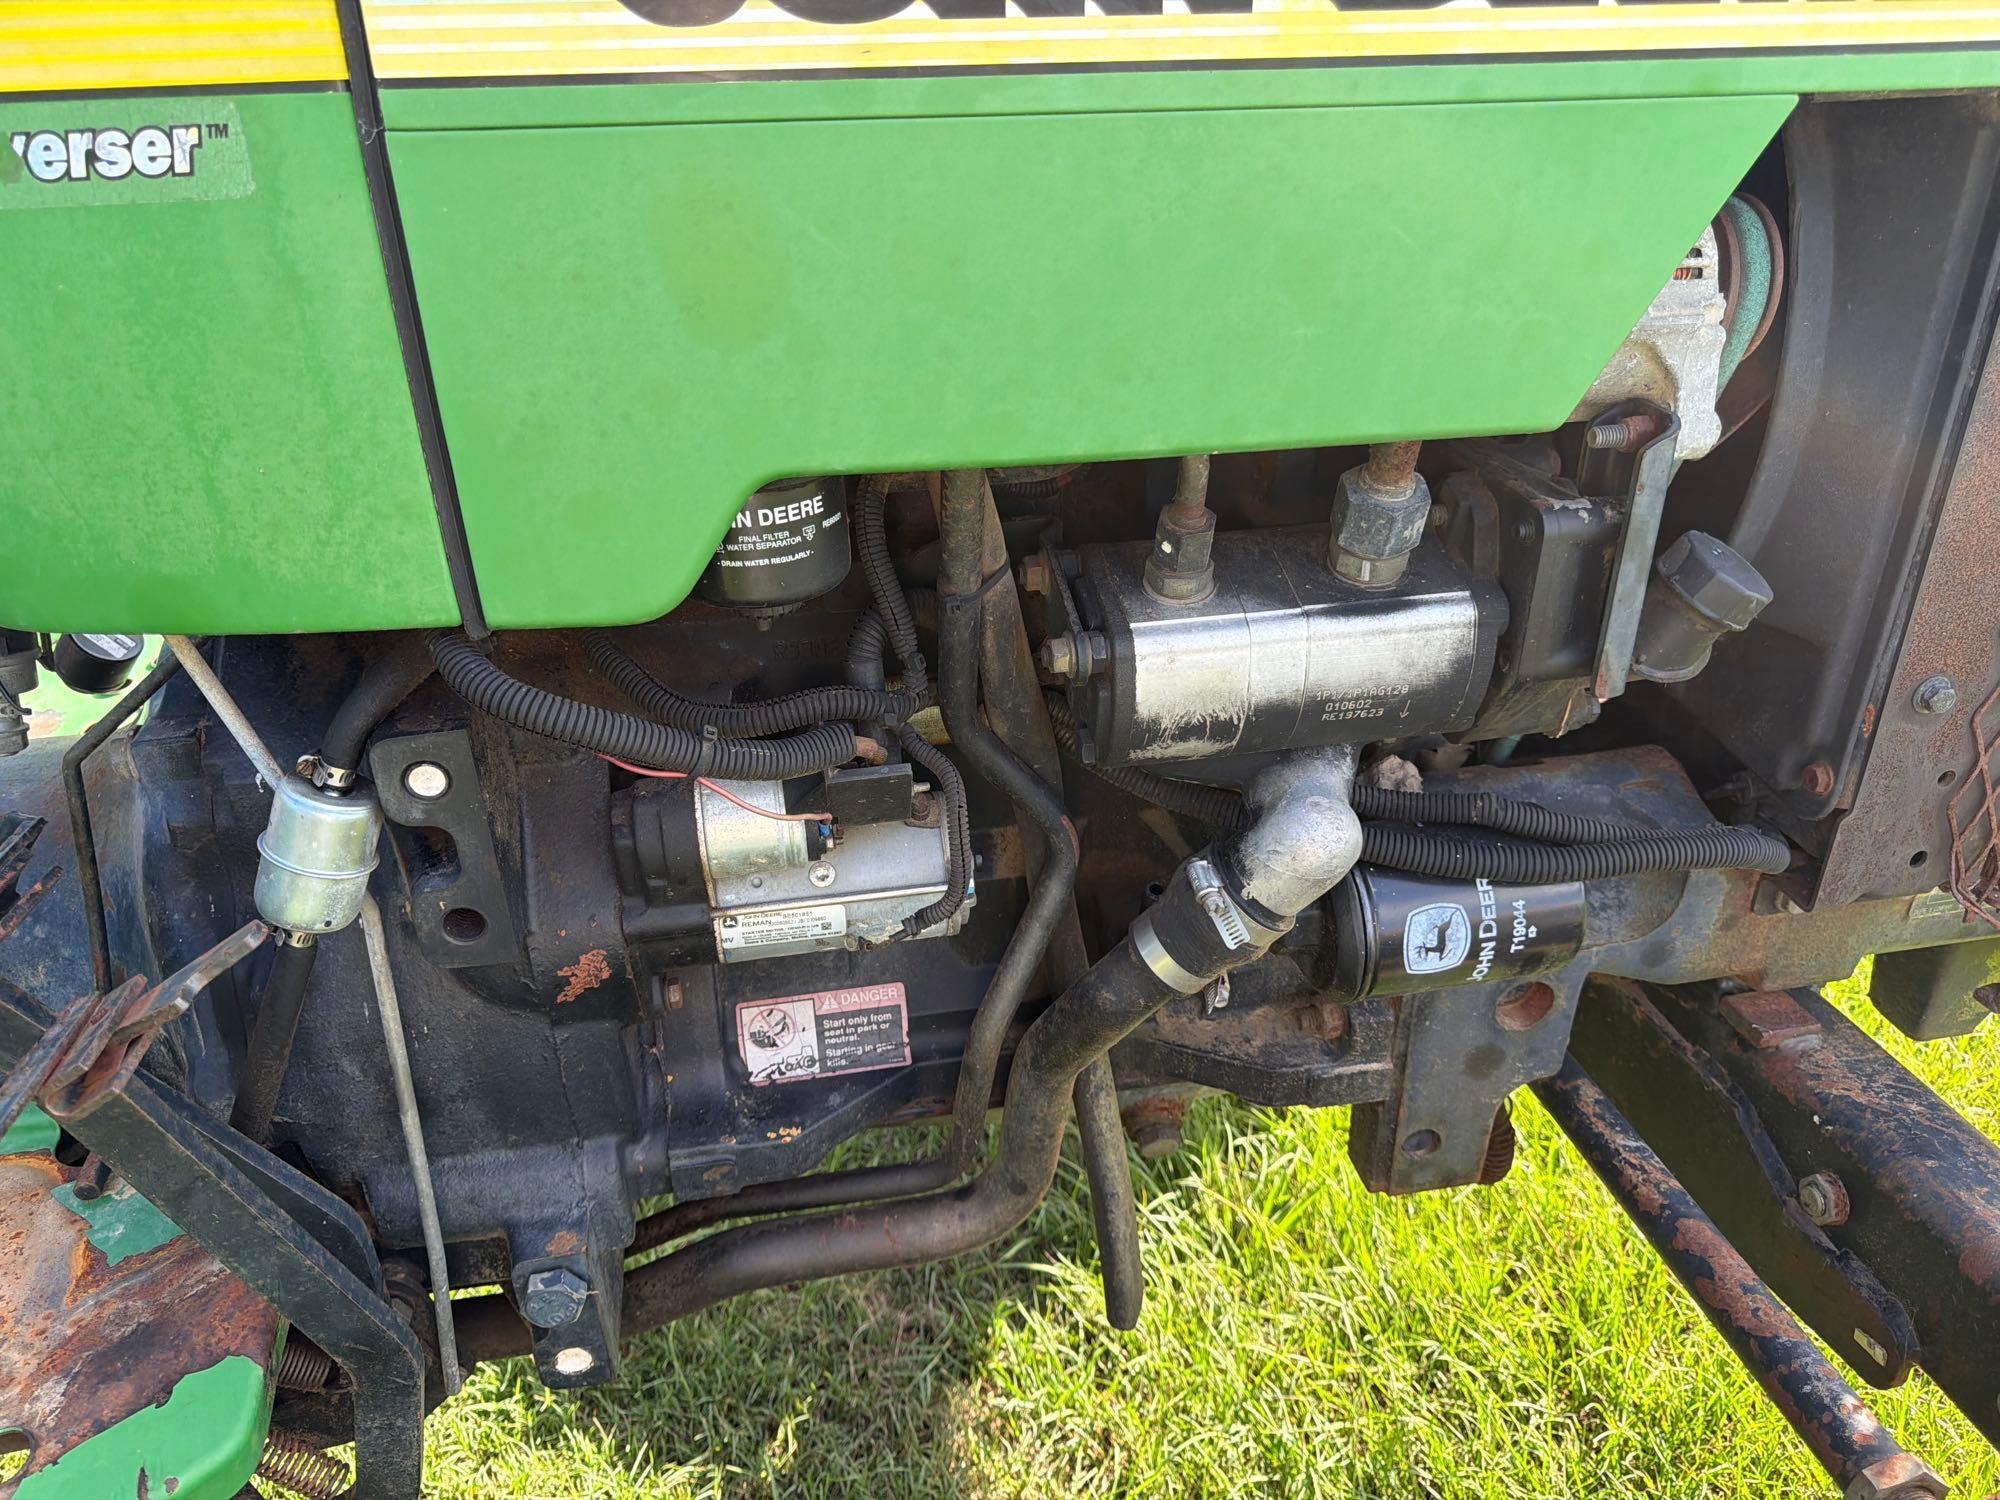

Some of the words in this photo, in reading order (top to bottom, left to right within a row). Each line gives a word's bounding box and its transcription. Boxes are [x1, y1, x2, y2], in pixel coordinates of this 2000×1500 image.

[731, 511, 752, 528] N
[757, 495, 824, 527] DEERE
[726, 543, 755, 551] WATER
[755, 536, 802, 550] SEPARATOR
[738, 535, 761, 543] FINAL
[762, 531, 790, 541] FILTER
[744, 558, 769, 567] WATER
[770, 550, 811, 564] REGULARLY
[1325, 700, 1372, 712] 010602
[1321, 708, 1384, 721] RE197623
[1475, 878, 1498, 938] DEER
[742, 920, 772, 928] REMAN
[1510, 899, 1526, 954] T19044
[1466, 940, 1495, 982] JOHN
[841, 987, 897, 1005] DANGER
[823, 1018, 846, 1029] Start
[848, 1015, 868, 1026] only
[870, 1013, 892, 1022] from
[824, 1028, 844, 1037] seat
[857, 1024, 878, 1034] park
[825, 1034, 860, 1044] neutral.
[825, 1046, 863, 1057] Starting
[865, 1043, 873, 1052] in
[826, 1058, 849, 1067] kills.
